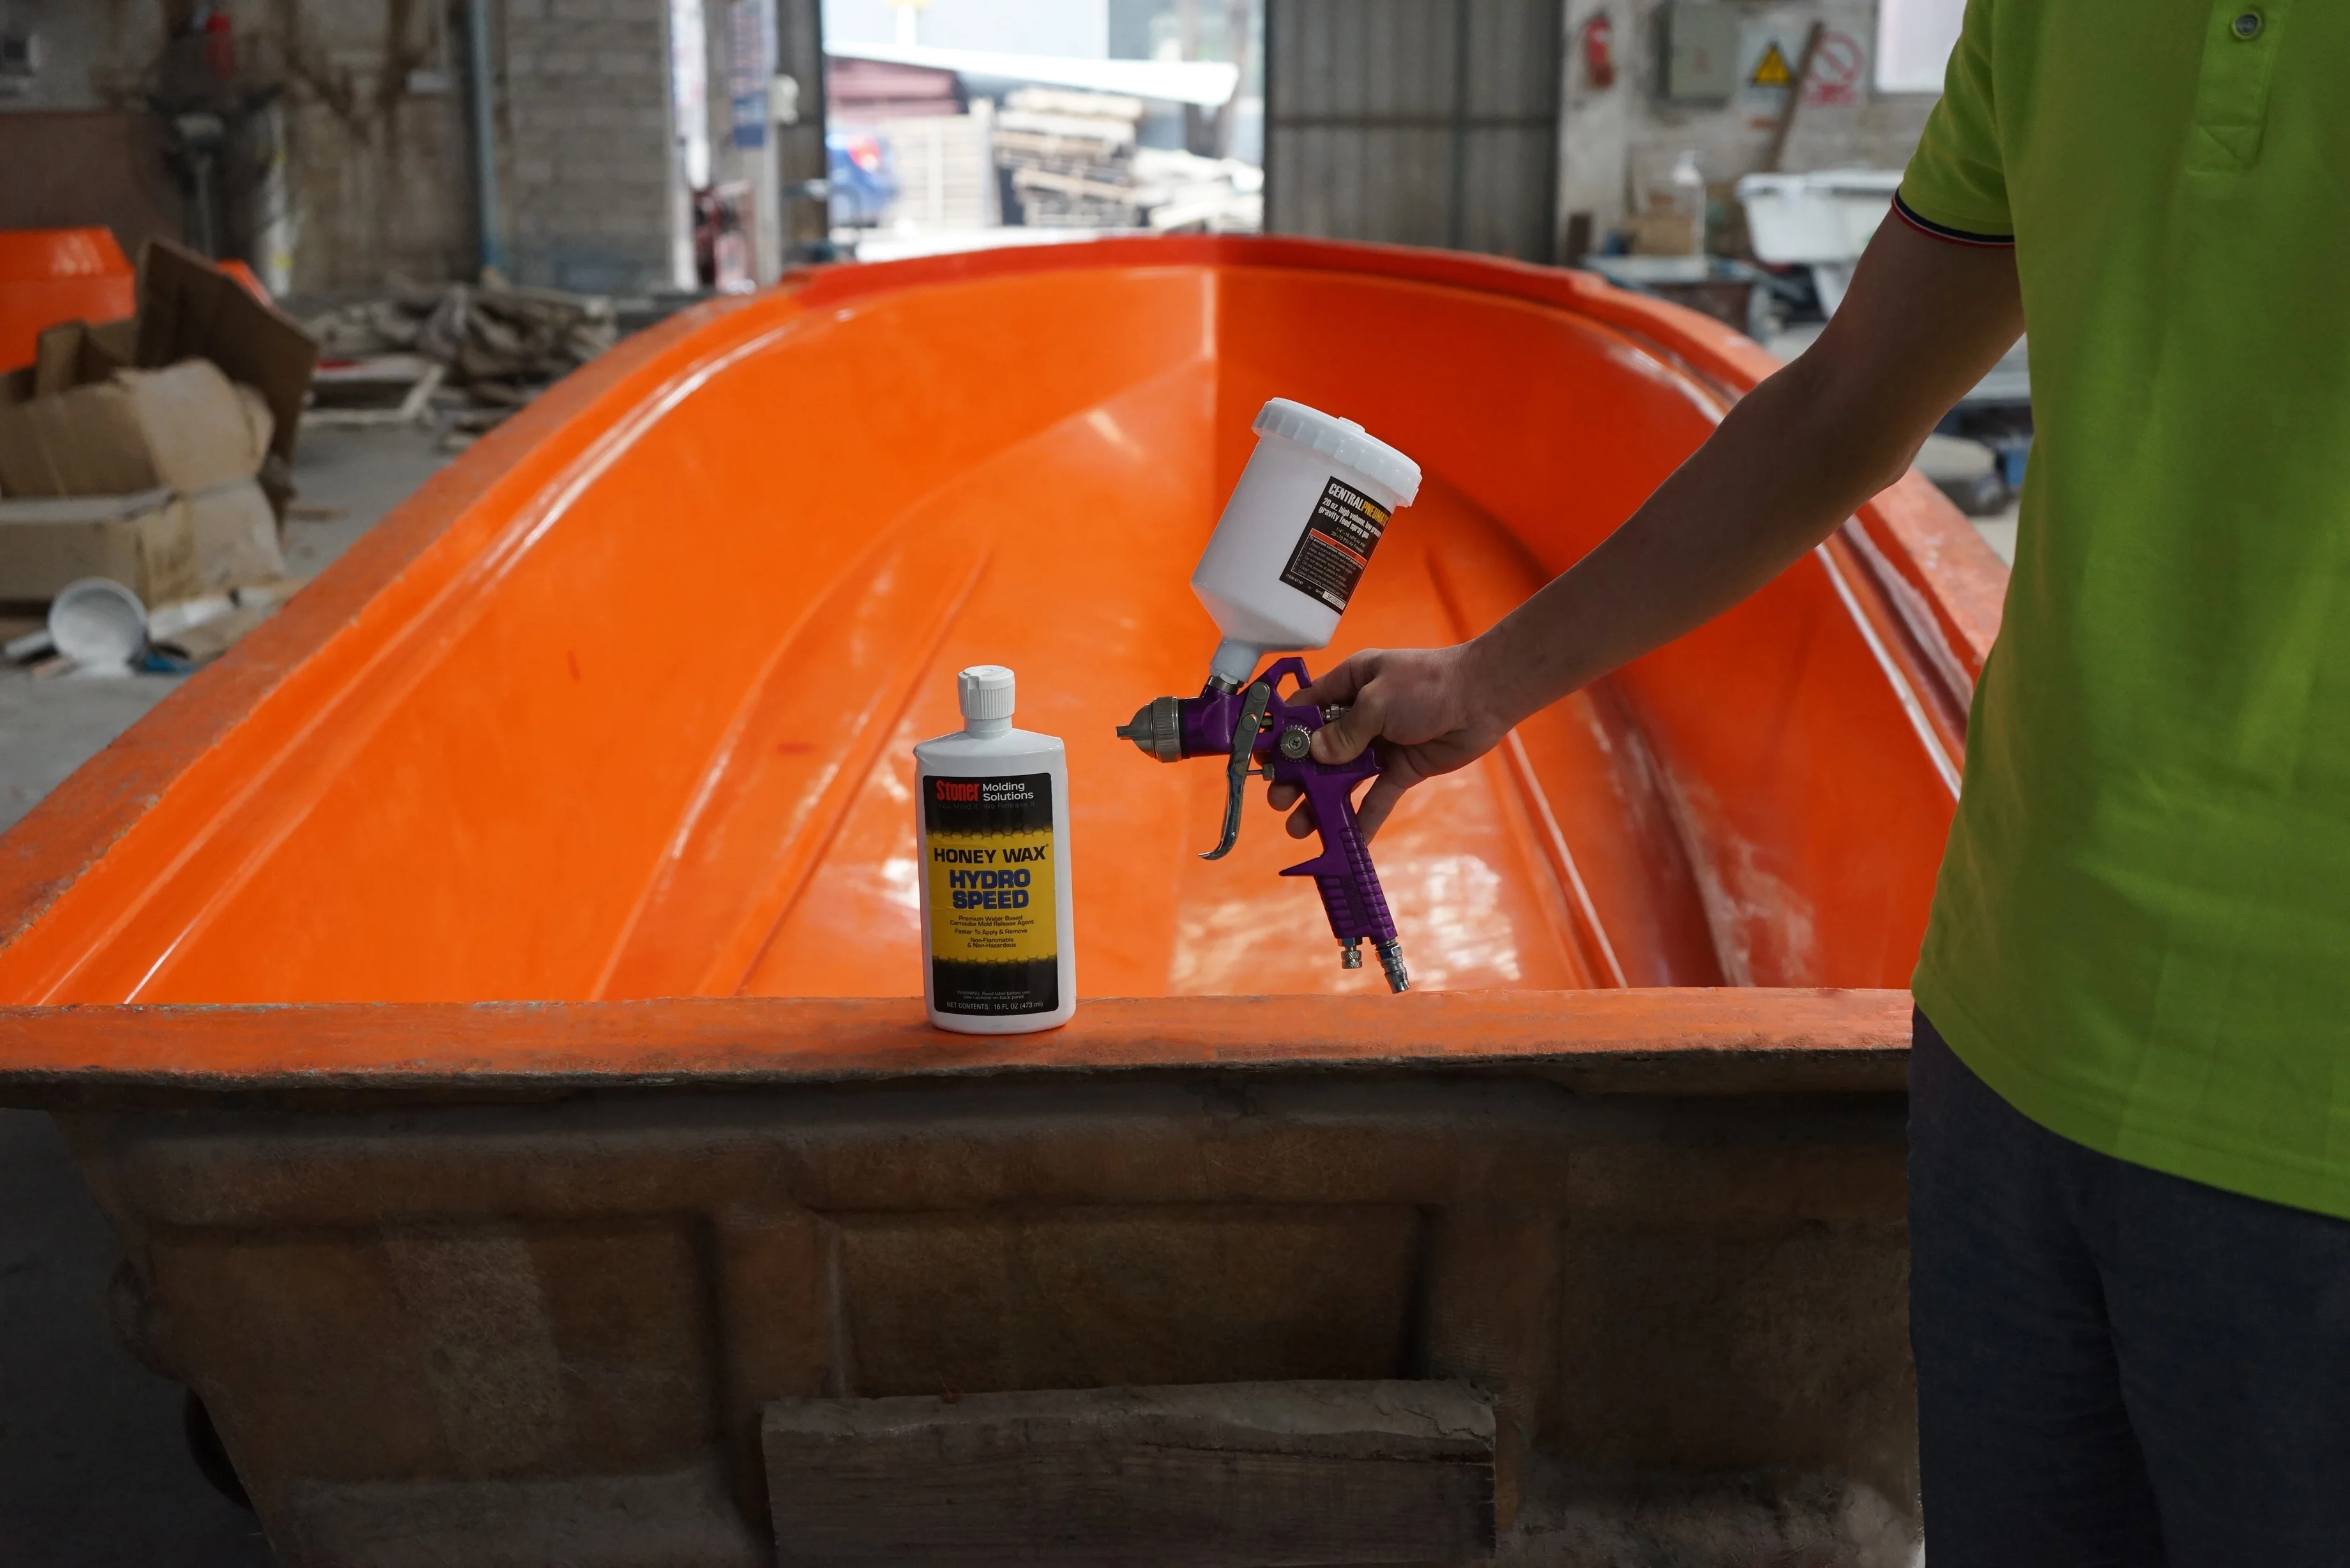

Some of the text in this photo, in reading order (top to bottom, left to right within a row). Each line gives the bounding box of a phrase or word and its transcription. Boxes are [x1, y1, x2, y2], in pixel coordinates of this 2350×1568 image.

[1317, 506, 1340, 522] gravity
[1338, 516, 1351, 527] feed
[1349, 524, 1363, 536] spray
[1322, 497, 1331, 506] 20
[1330, 502, 1339, 511] oz.
[1337, 505, 1351, 518] high
[1364, 521, 1373, 531] low
[936, 780, 980, 801] Stoner
[983, 782, 1025, 792] Molding
[983, 792, 1033, 801] Solutions
[934, 848, 996, 864] HONEY
[950, 869, 1030, 889] HYDRO
[953, 890, 1029, 909] SPEED
